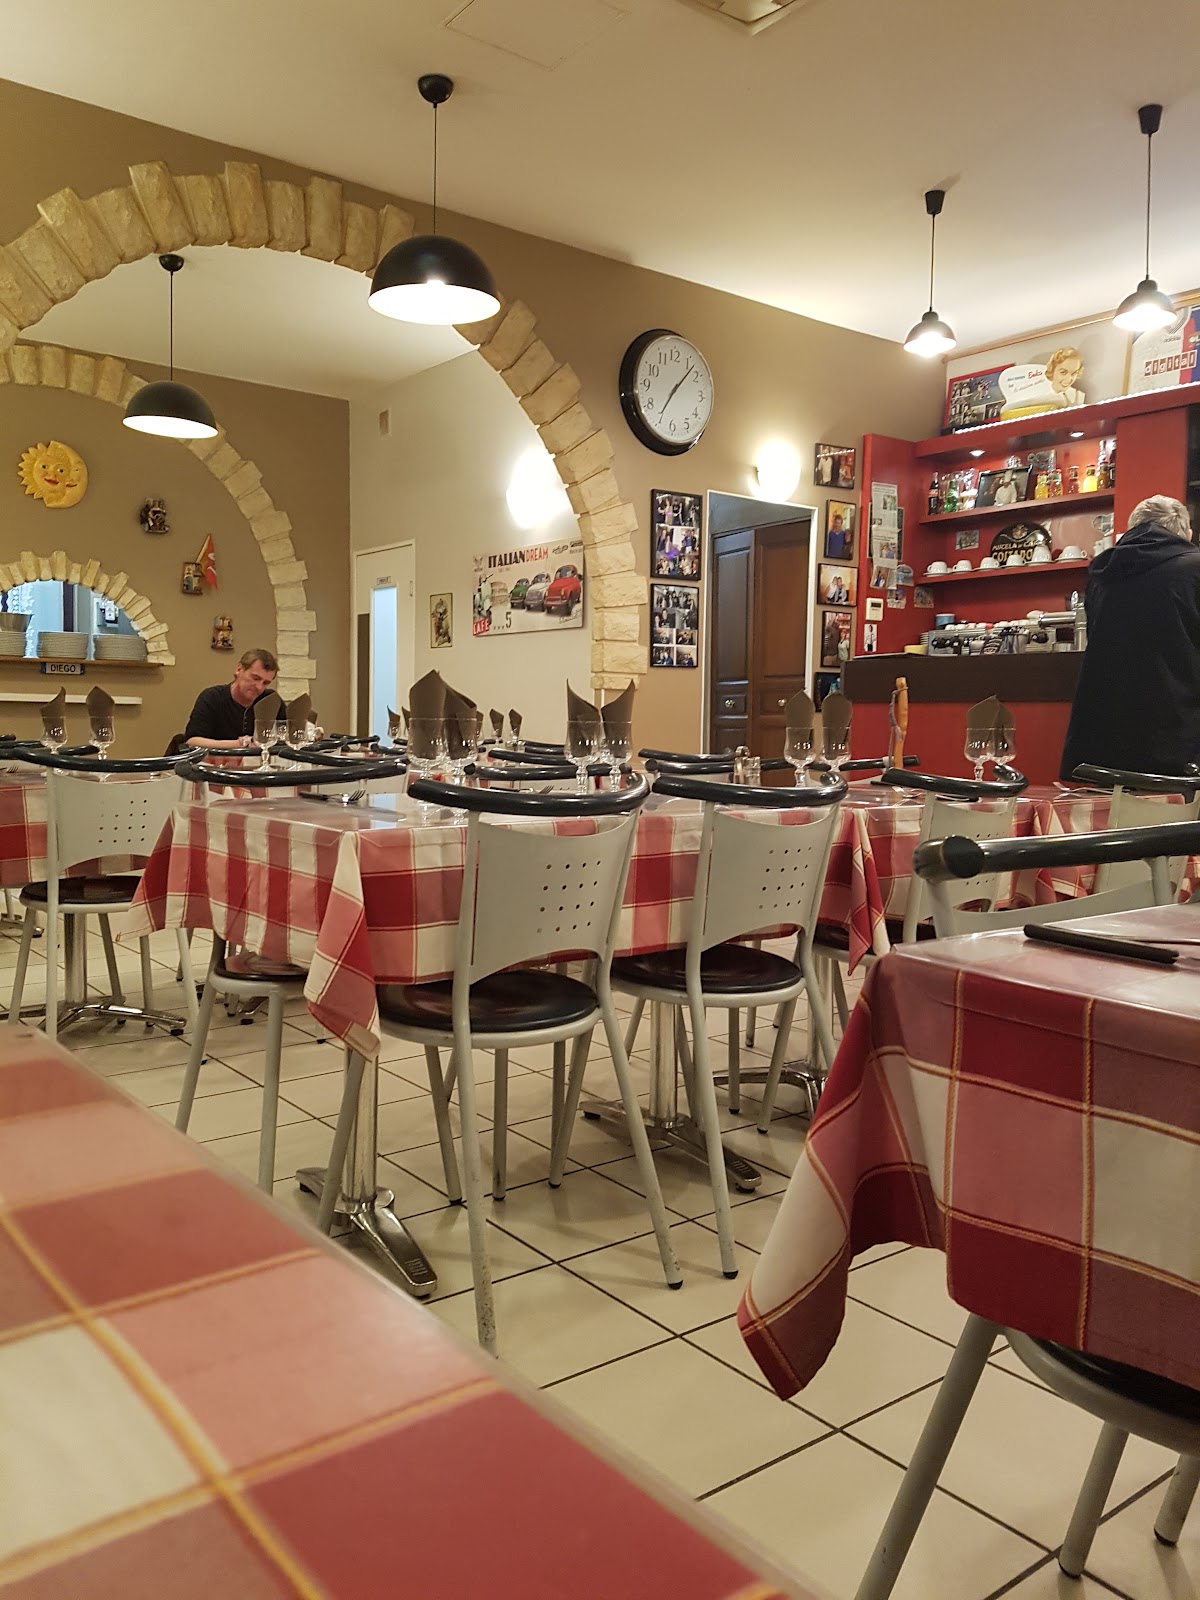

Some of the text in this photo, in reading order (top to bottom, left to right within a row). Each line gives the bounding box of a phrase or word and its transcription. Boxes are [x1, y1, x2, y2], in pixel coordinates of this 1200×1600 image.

[658, 351, 667, 366] 11
[669, 348, 681, 363] 12
[685, 357, 690, 370] 1
[1144, 350, 1196, 376] digital
[648, 363, 660, 378] 10
[692, 370, 699, 383] 2
[643, 378, 651, 392] 9
[646, 397, 654, 410] 8
[698, 391, 704, 403] 3
[691, 407, 699, 419] 4
[668, 419, 677, 433] 6
[683, 417, 690, 430] 5
[50, 664, 76, 673] DIEGO
